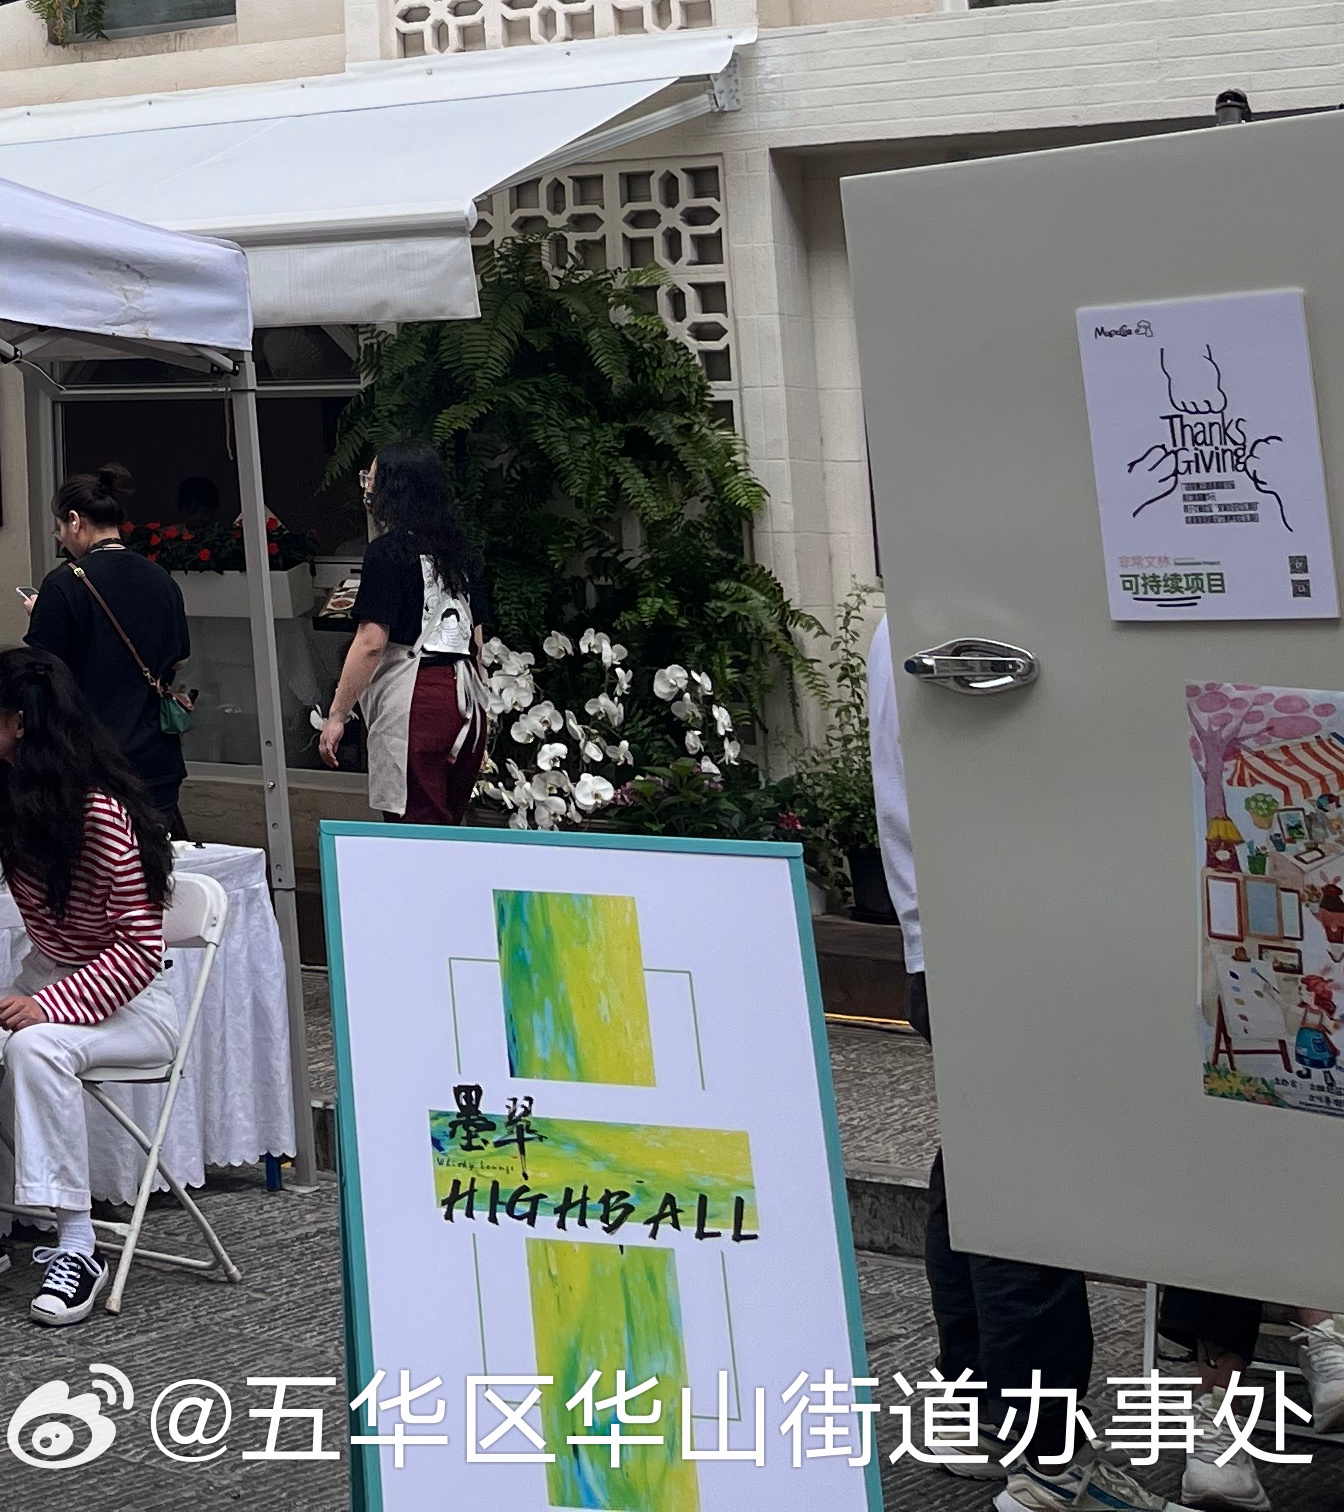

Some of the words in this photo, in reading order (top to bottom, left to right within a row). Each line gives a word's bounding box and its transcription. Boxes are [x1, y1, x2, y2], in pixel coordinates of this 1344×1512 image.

[1160, 411, 1246, 447] Thanks
[1173, 445, 1247, 476] Giving
[1119, 572, 1226, 596] 可持续项目
[441, 1177, 759, 1243] HIGHBALL
